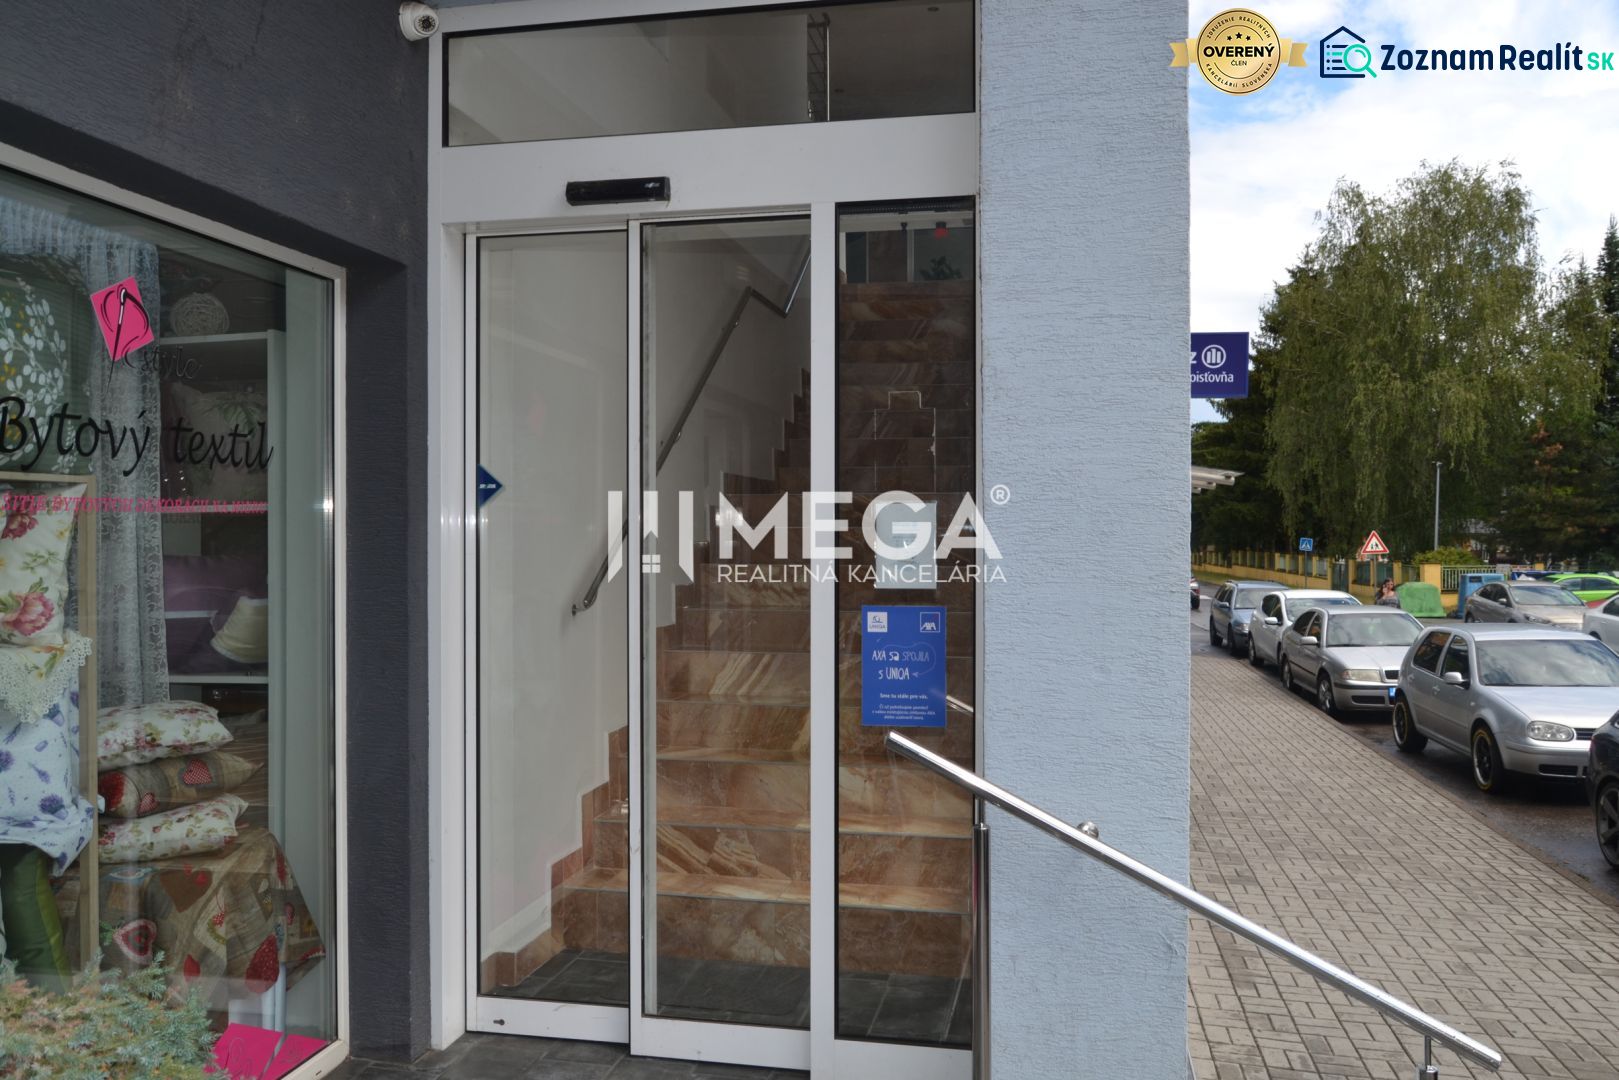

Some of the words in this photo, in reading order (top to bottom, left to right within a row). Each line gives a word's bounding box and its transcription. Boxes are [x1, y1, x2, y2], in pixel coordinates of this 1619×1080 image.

[0, 396, 151, 478] Bytový
[920, 622, 937, 631] AXA
[872, 650, 886, 661] AXA
[885, 667, 910, 680] UNIQA
